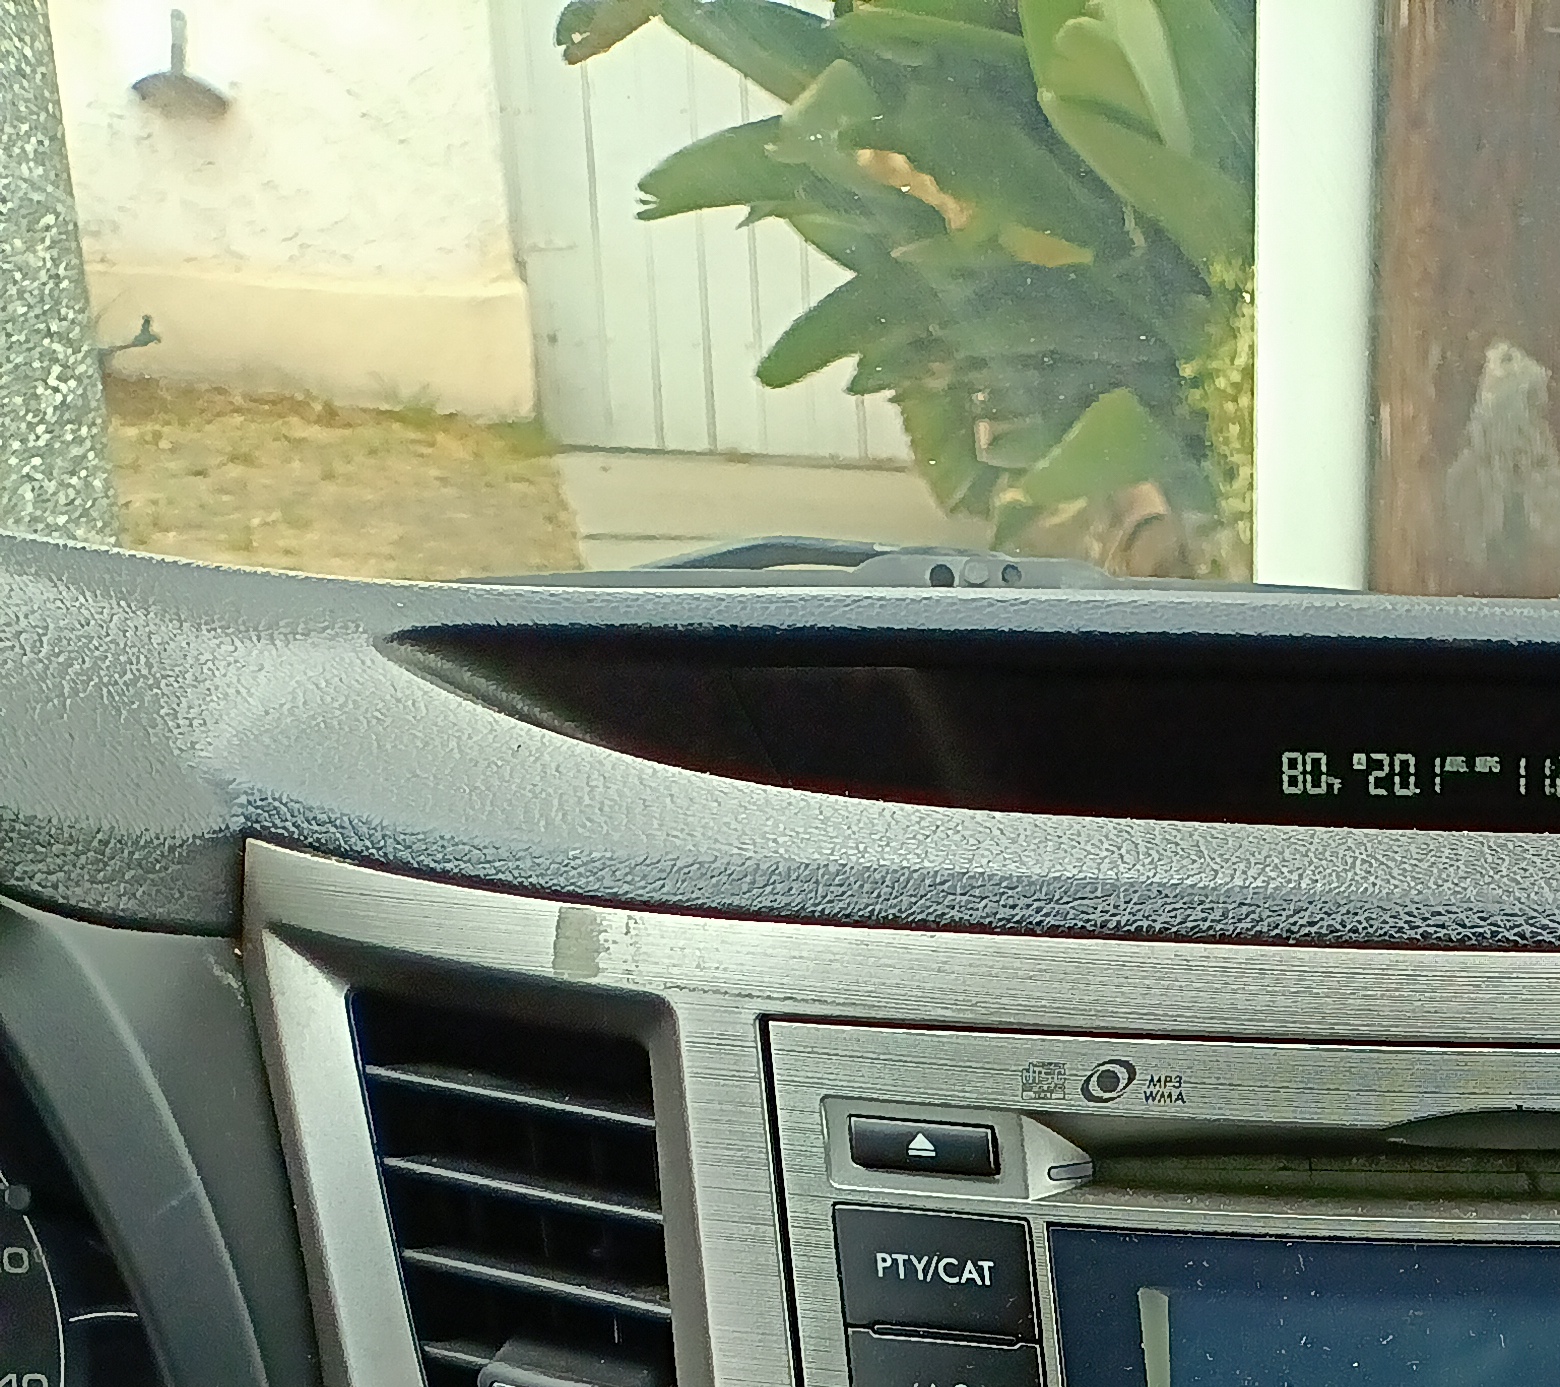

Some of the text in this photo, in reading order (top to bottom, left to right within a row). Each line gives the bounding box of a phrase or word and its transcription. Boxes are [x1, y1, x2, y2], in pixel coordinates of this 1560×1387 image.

[1147, 1074, 1184, 1090] MP3
[1144, 1089, 1187, 1105] WMA
[875, 1252, 995, 1286] PTY/CAT
